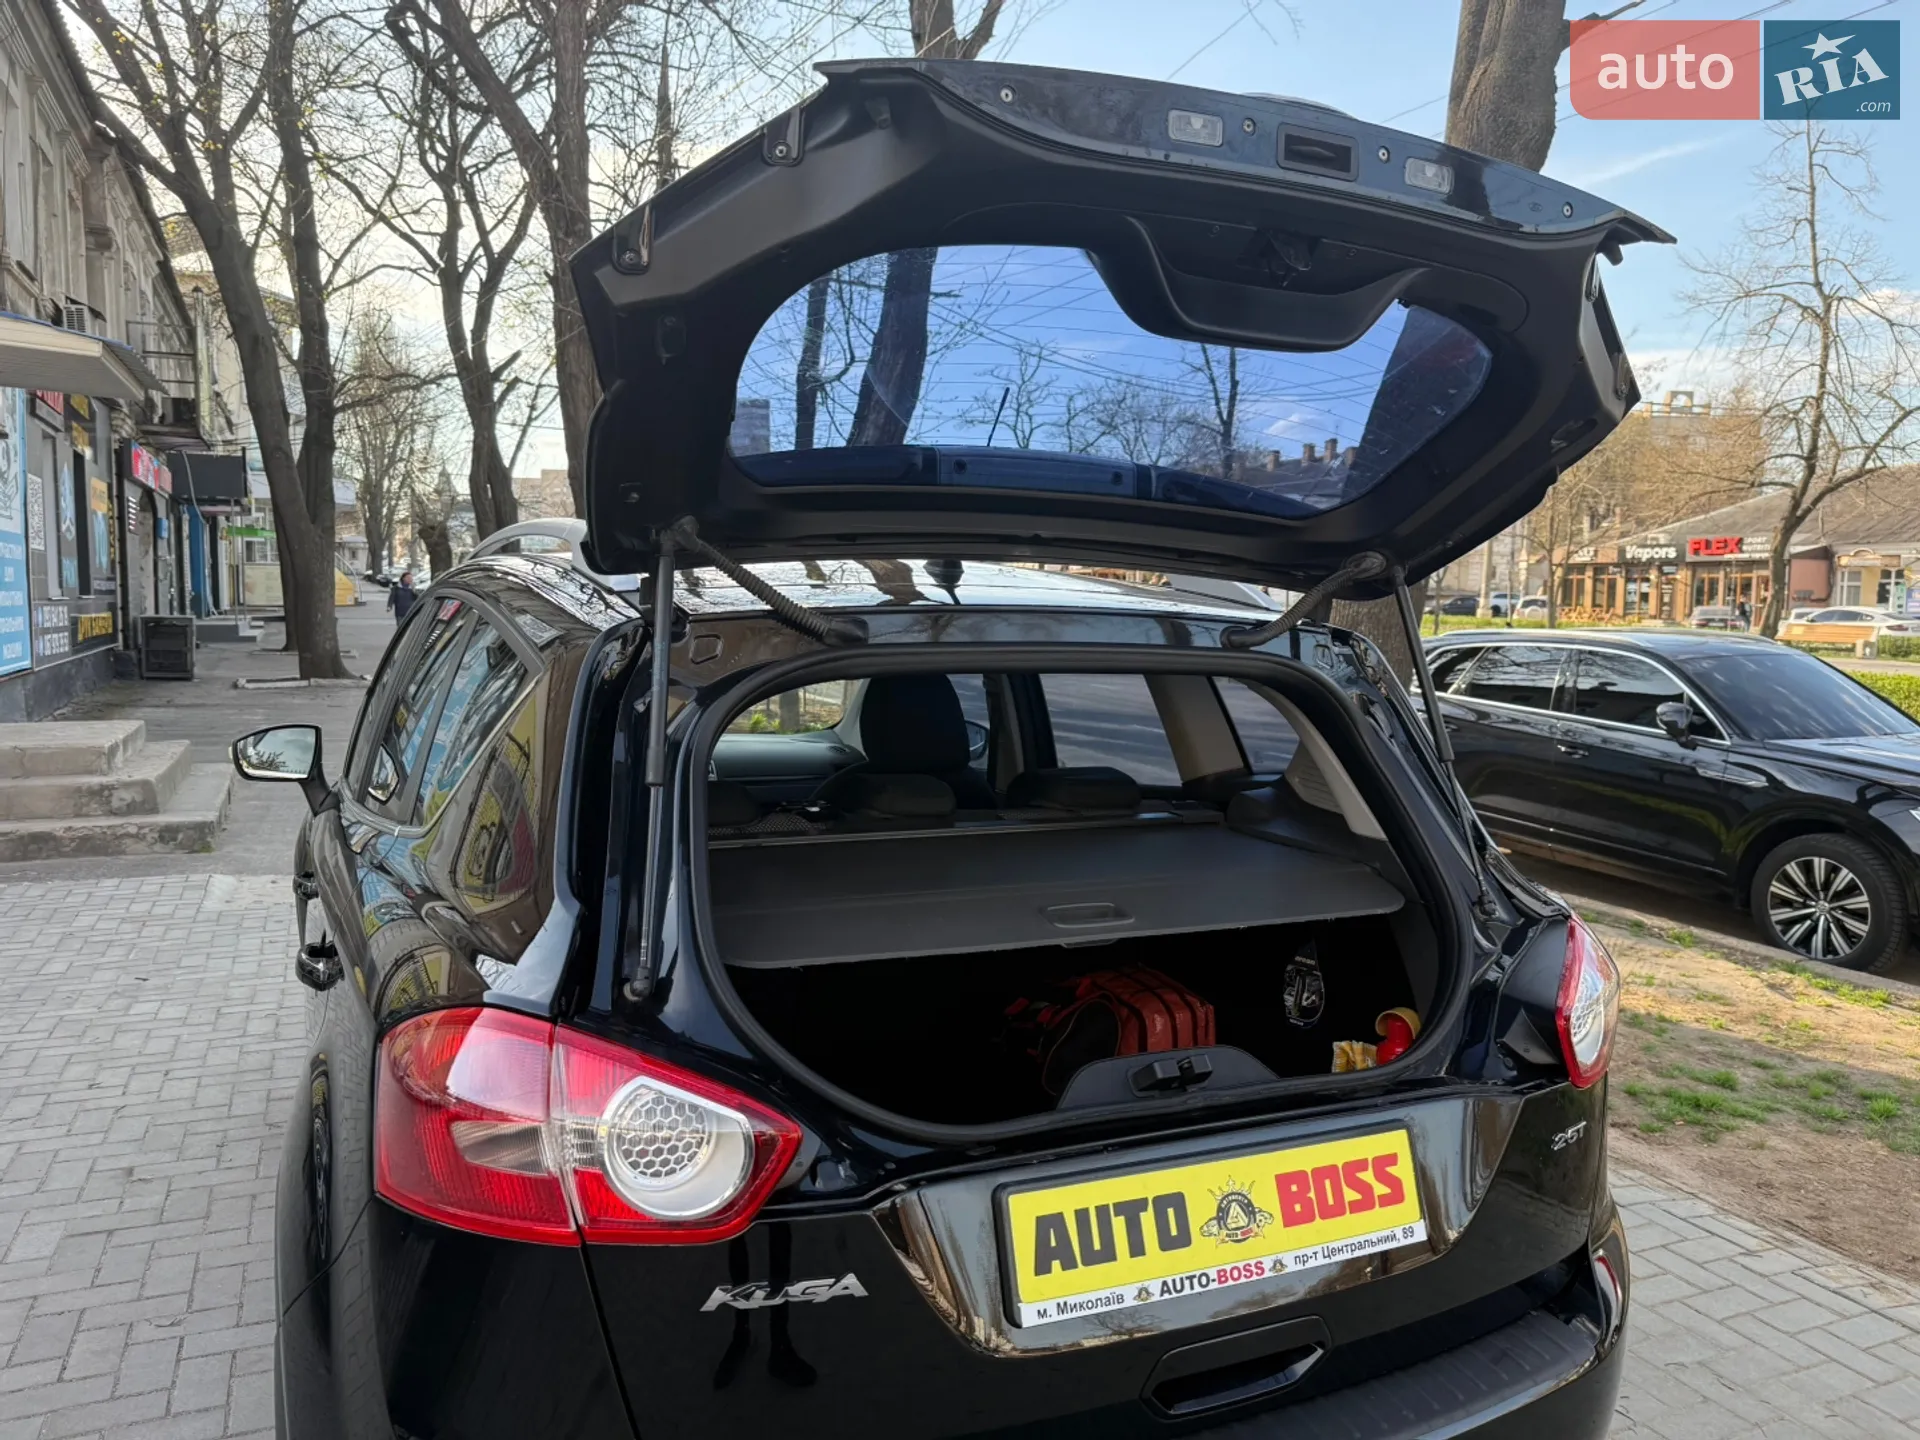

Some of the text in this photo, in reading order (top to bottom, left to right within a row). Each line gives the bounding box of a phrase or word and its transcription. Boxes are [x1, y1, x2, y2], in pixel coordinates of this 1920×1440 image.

[1625, 545, 1677, 562] Vapors
[1688, 536, 1742, 557] FLEX
[1034, 1152, 1405, 1277] AUTO BOSS
[699, 1272, 870, 1312] KUGA
[1036, 1225, 1415, 1320] м. Миколаїв AUTO-BOSS пр-т Центральний, 89
